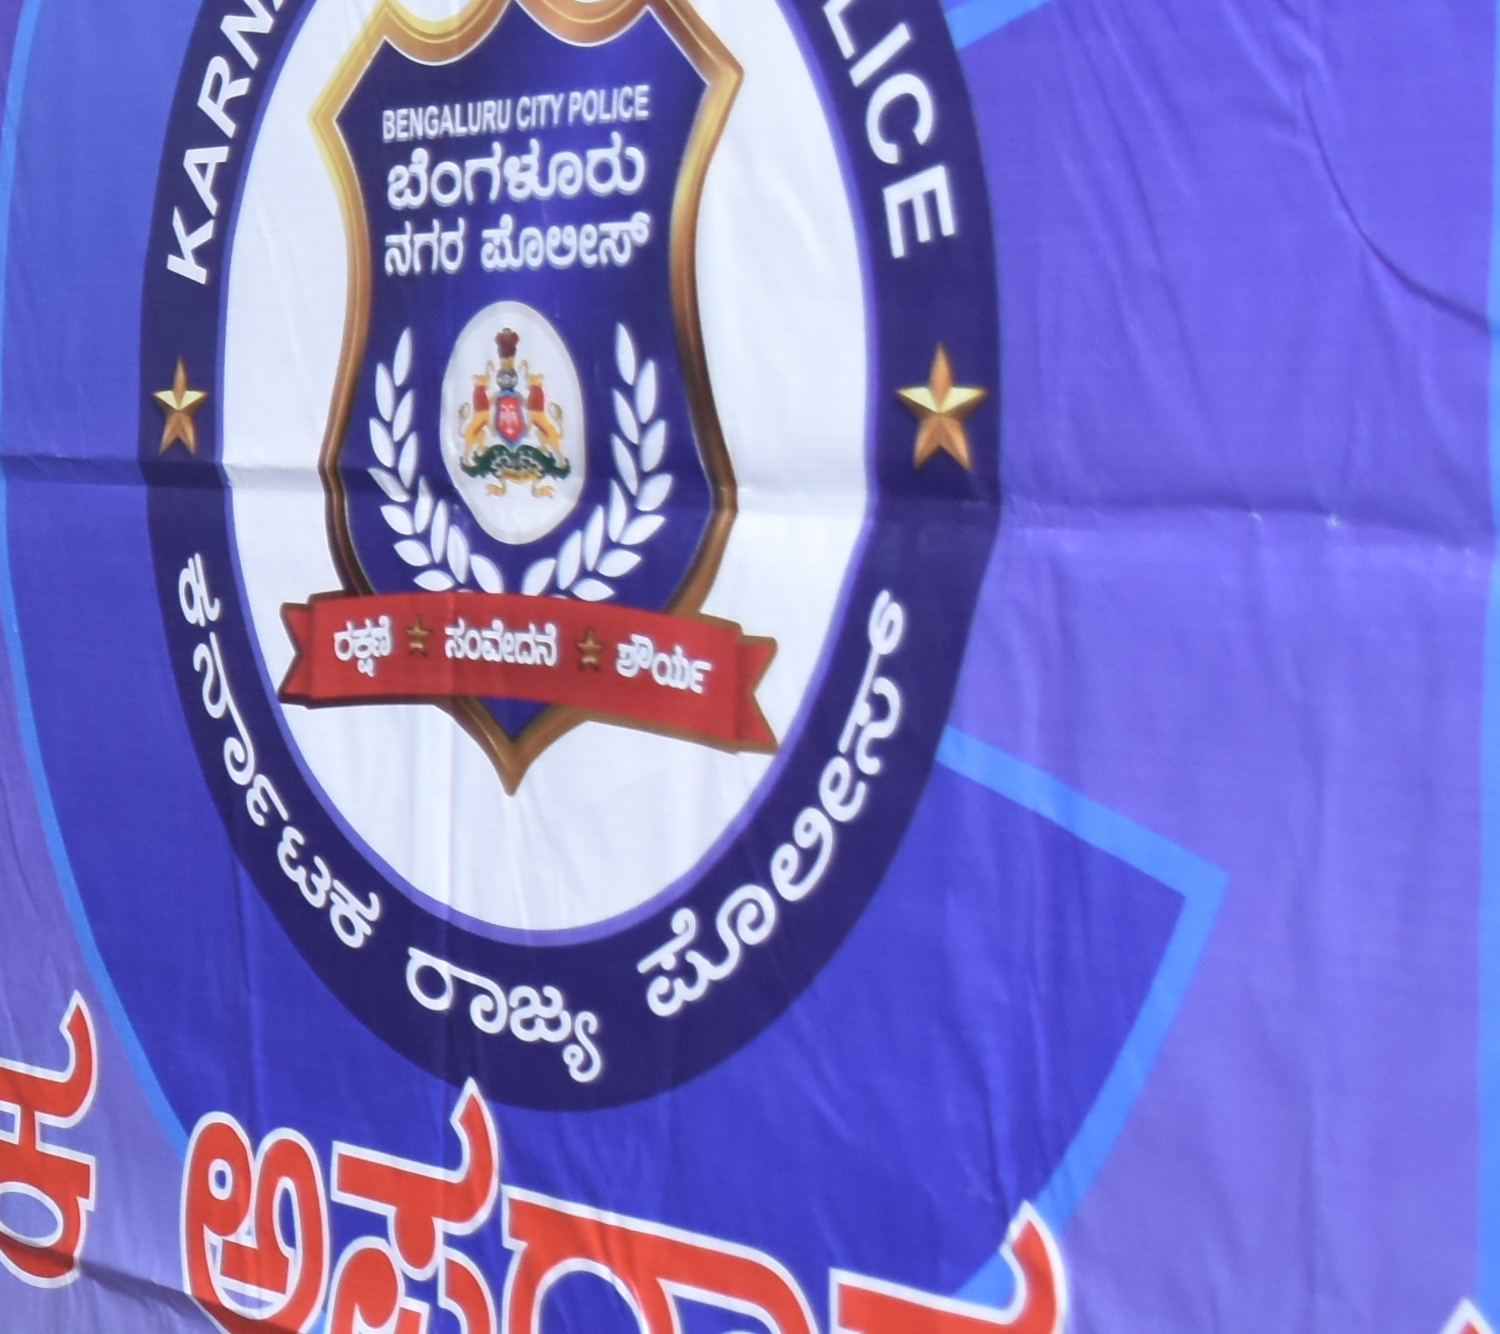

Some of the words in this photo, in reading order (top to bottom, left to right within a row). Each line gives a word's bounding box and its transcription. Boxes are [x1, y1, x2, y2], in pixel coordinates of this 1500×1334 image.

[382, 99, 512, 143] BENGALURU
[515, 93, 565, 130] CITY
[567, 84, 651, 125] POLICE
[386, 130, 647, 209] ಬೆಂಗಳೂರು
[383, 217, 465, 276] ನಗರ
[405, 945, 603, 1084] ರಾಜ್ಯ
